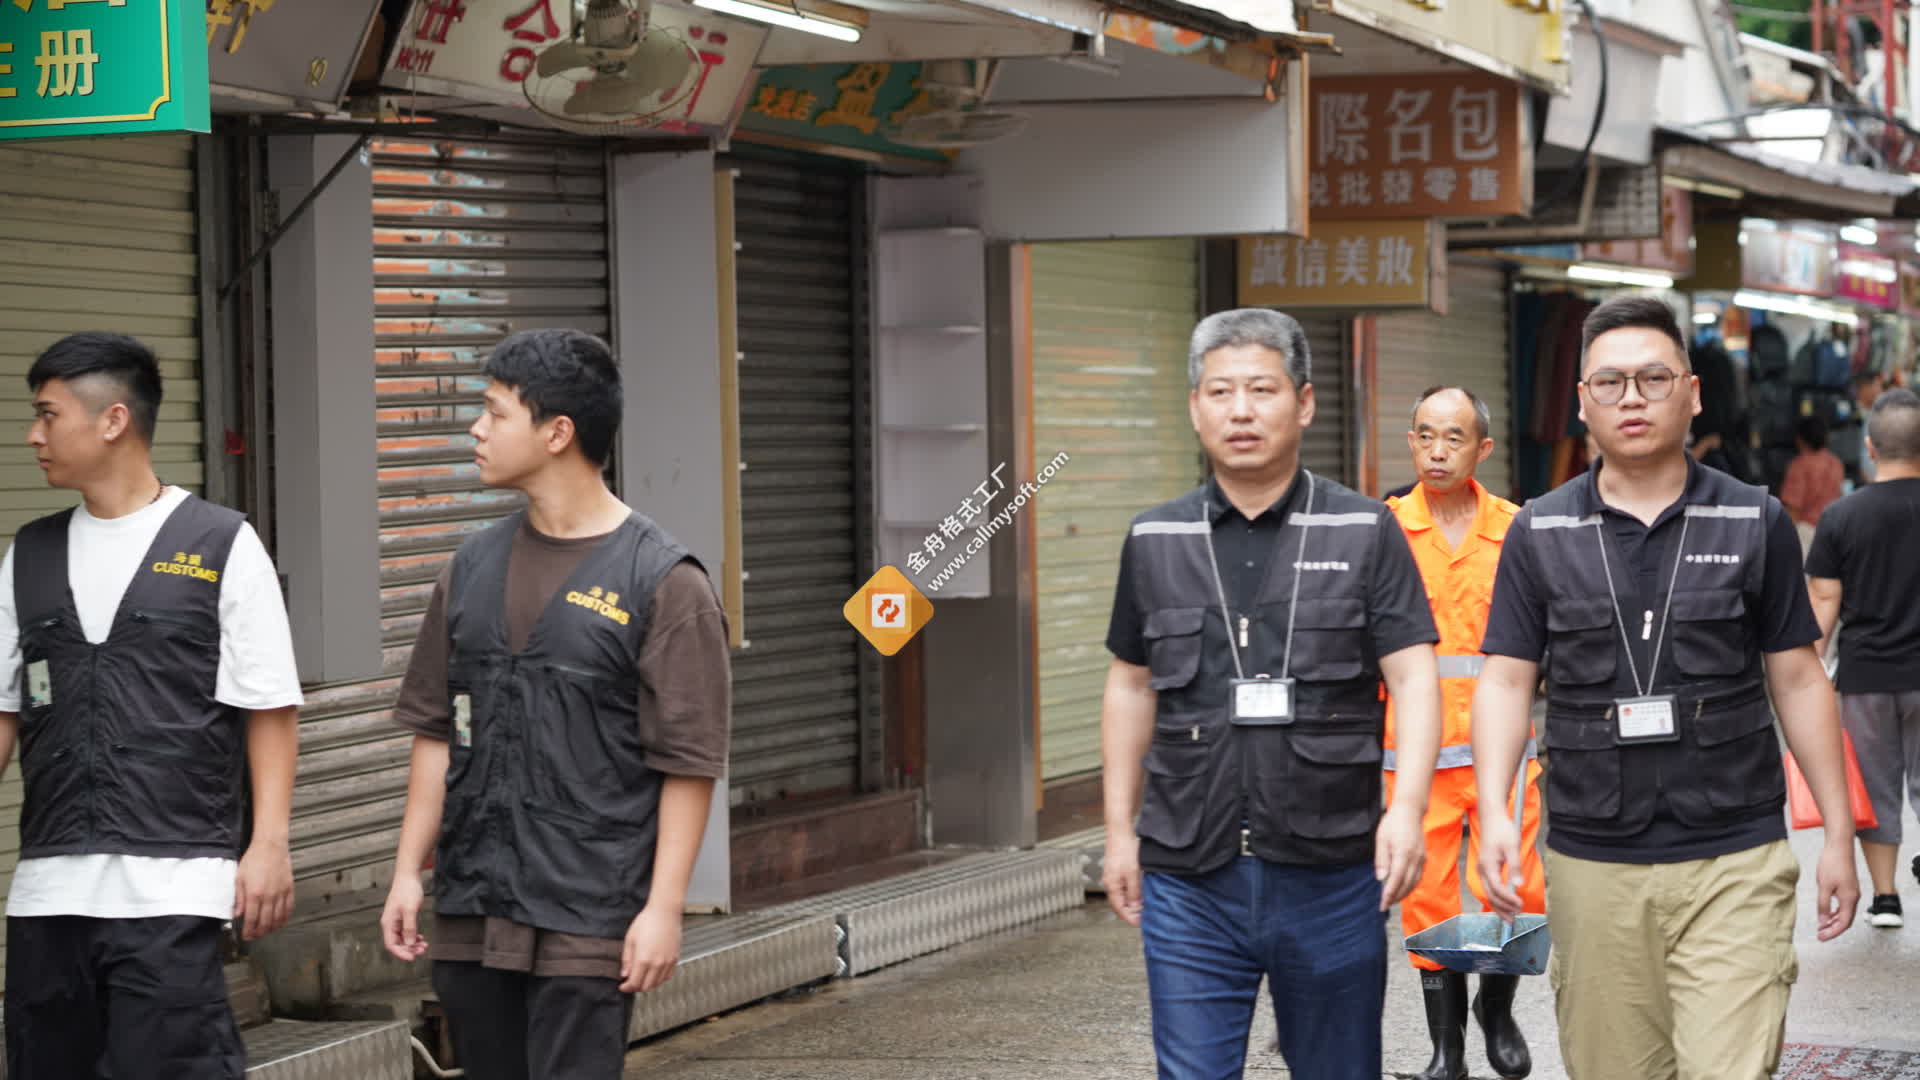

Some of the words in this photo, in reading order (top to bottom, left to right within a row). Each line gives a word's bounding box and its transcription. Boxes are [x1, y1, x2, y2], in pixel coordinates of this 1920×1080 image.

[1317, 87, 1498, 165] 際名包
[152, 561, 219, 583] CUSTOMS
[565, 591, 631, 625] CUSTOMS
